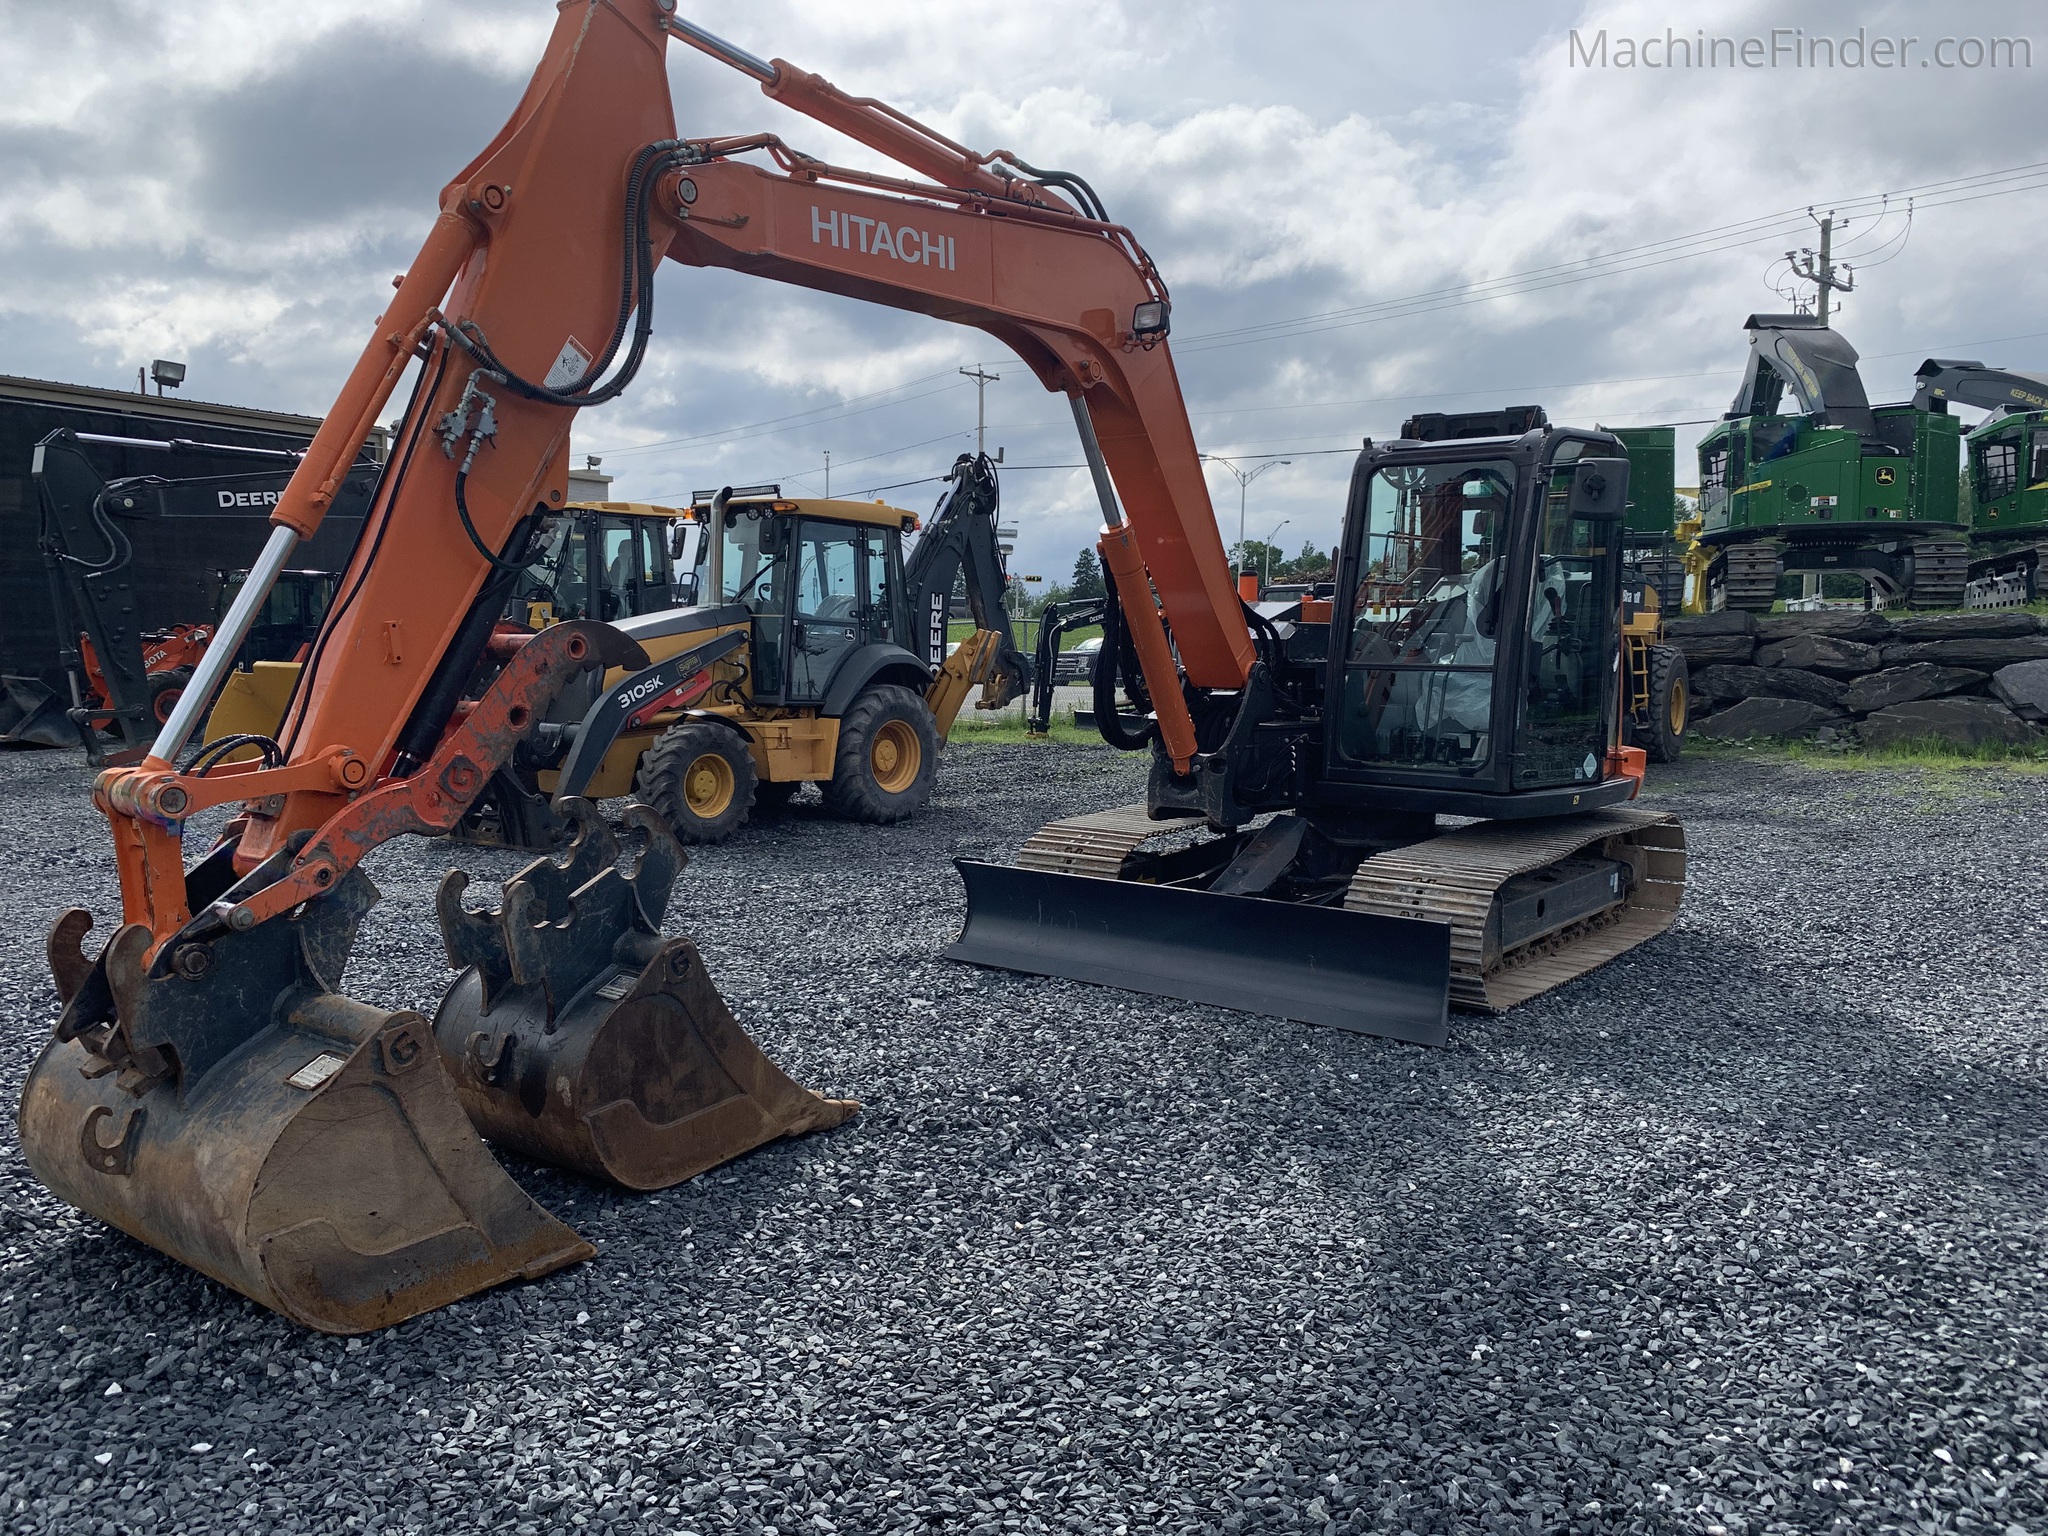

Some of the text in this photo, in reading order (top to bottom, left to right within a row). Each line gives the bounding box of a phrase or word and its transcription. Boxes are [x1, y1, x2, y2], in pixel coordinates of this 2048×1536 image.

[811, 205, 956, 271] HITACHI
[2010, 388, 2027, 399] KEEP
[2025, 391, 2044, 405] BACK
[617, 674, 664, 709] 310SK
